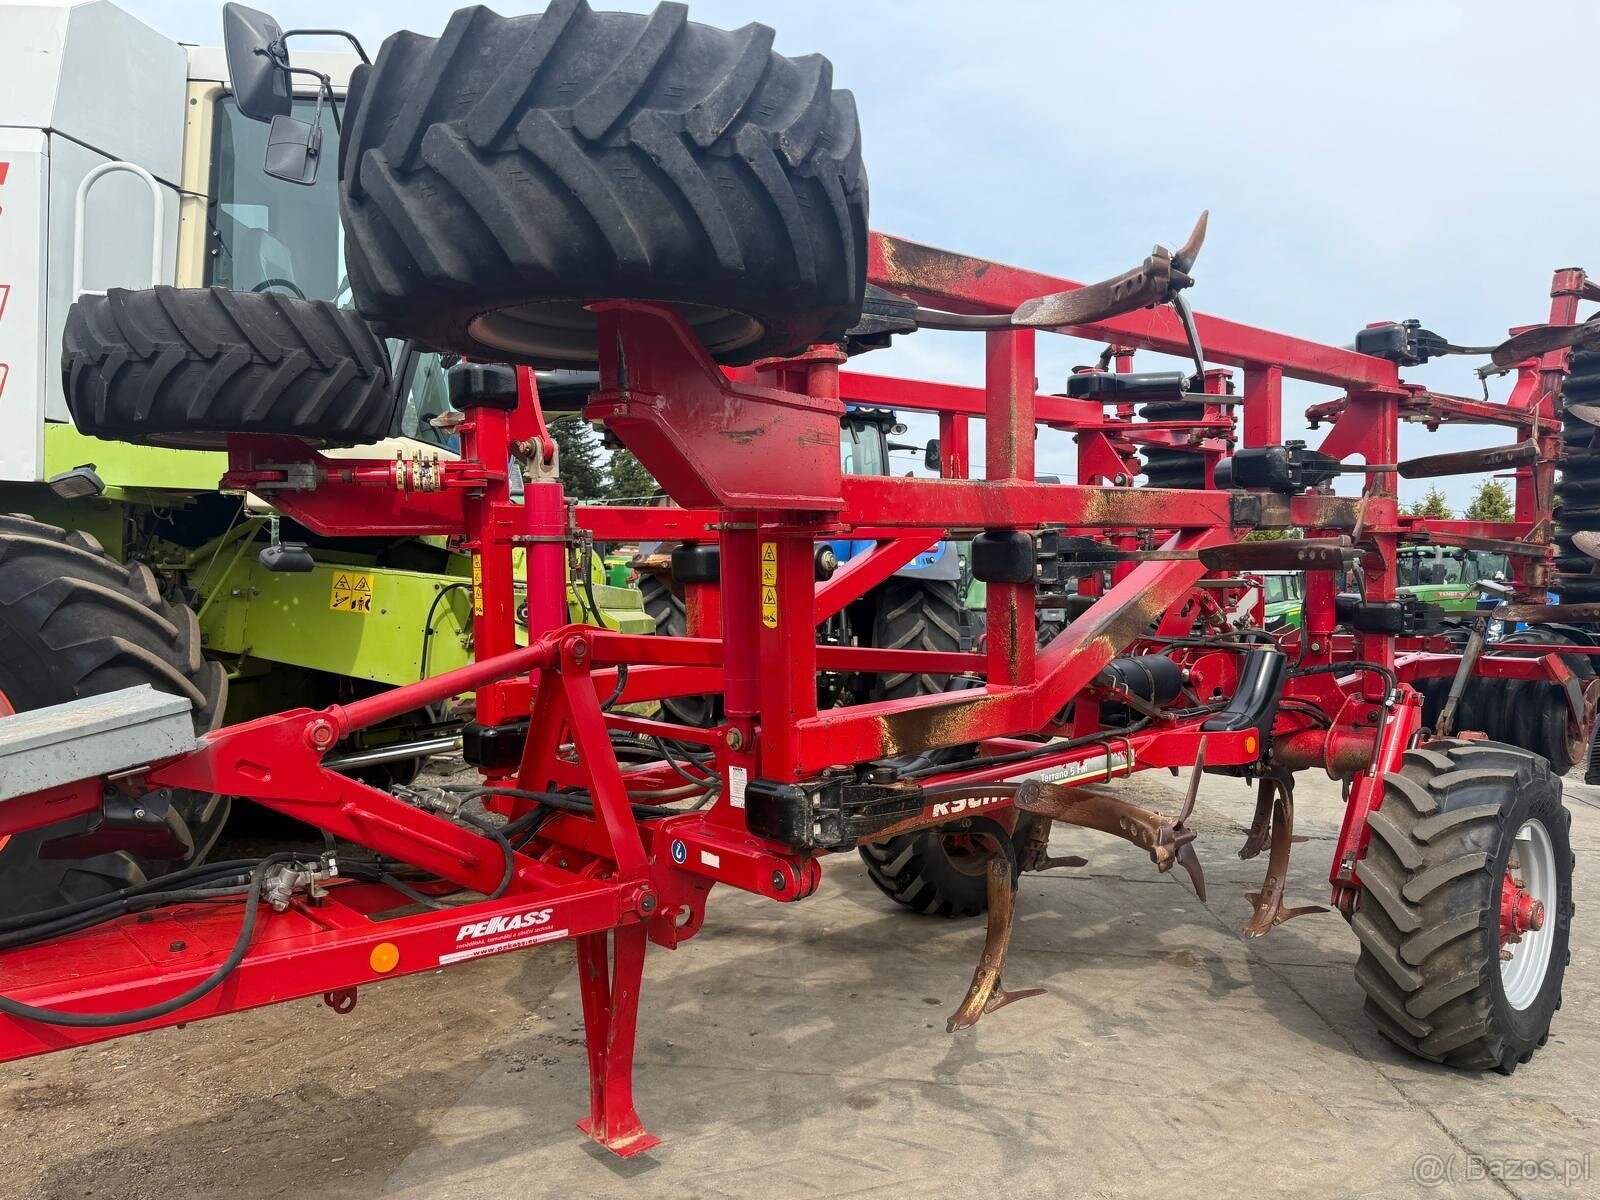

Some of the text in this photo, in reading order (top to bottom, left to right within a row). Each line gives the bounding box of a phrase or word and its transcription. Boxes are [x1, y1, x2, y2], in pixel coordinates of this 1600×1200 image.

[1040, 771, 1068, 782] Terrano
[1070, 766, 1075, 775] 5
[473, 938, 537, 956] www.pekass.eu
